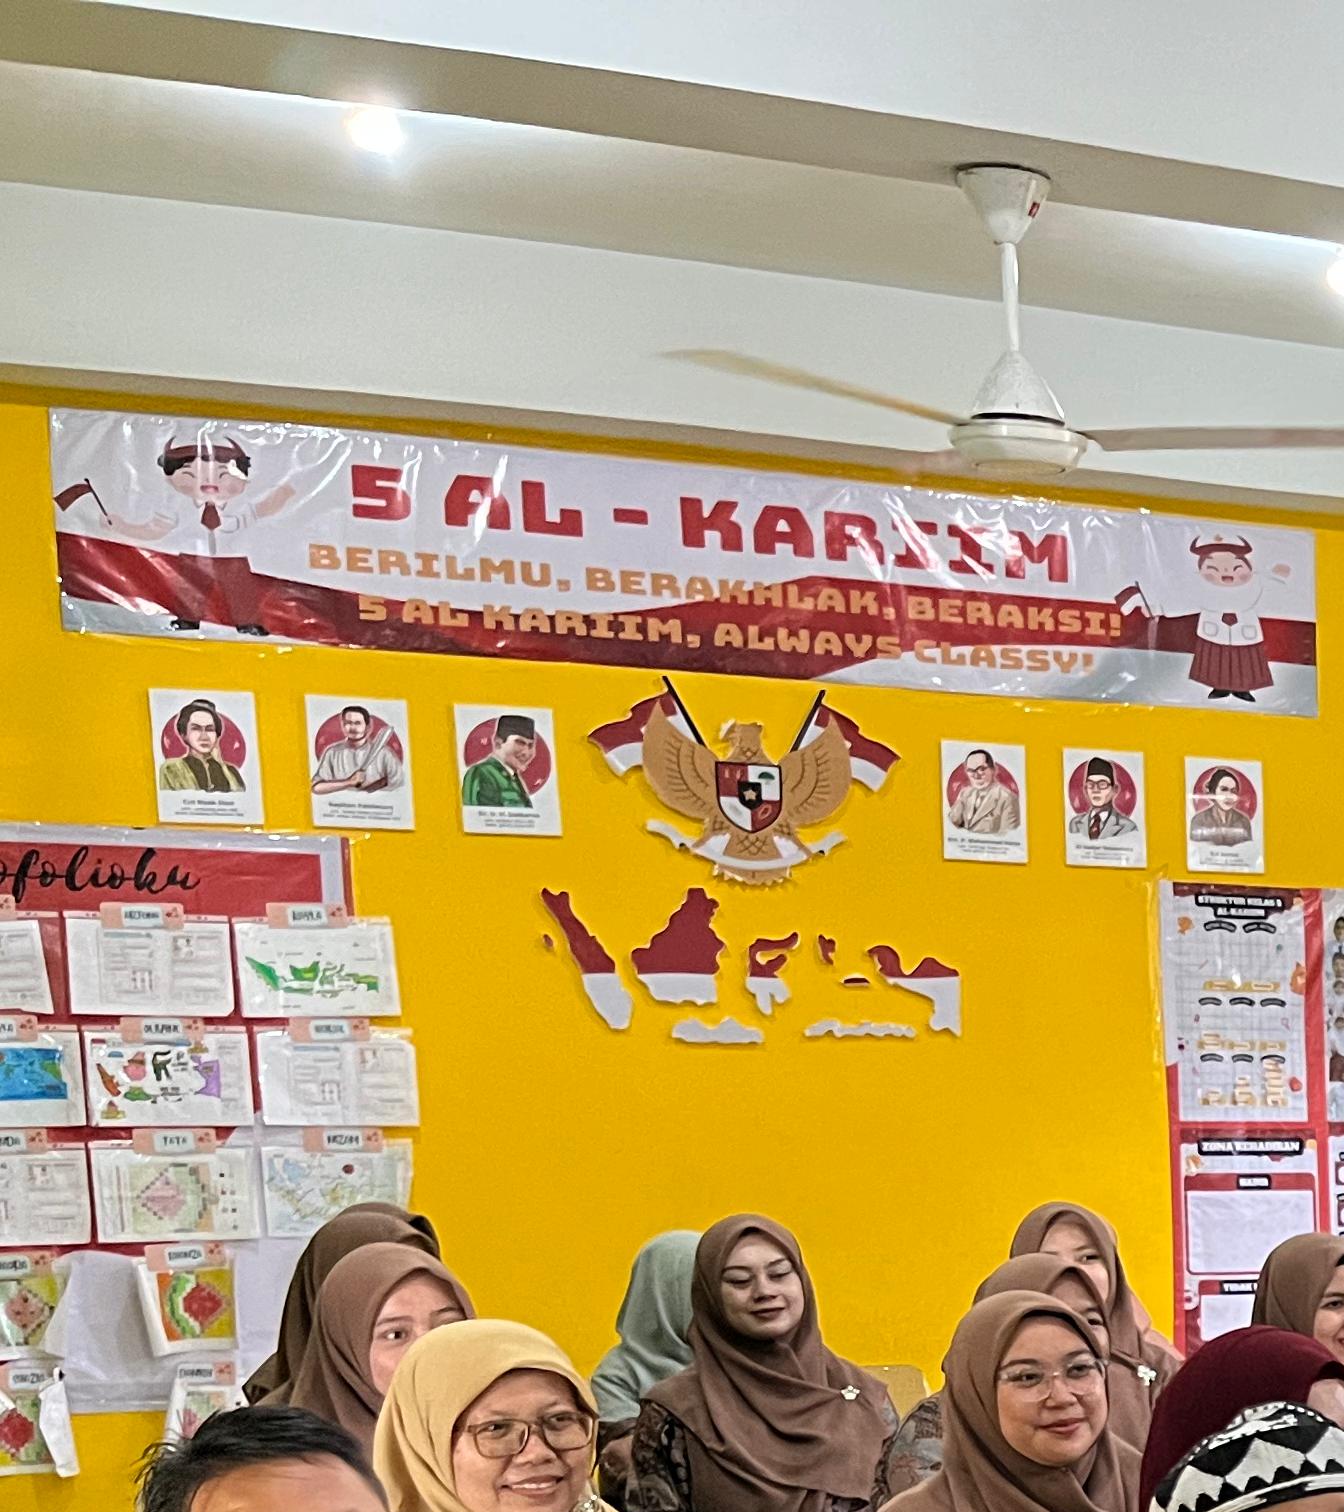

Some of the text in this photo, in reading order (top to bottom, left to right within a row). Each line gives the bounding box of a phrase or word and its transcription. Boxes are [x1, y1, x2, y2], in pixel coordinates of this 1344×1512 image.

[351, 463, 1069, 583] 5 AL - KARIIM
[308, 542, 1121, 637] BERILMU, BERAKHLAK, BERAKSI!
[358, 595, 1095, 674] 5 AL KARIIM, ALWAYS CLASSY!
